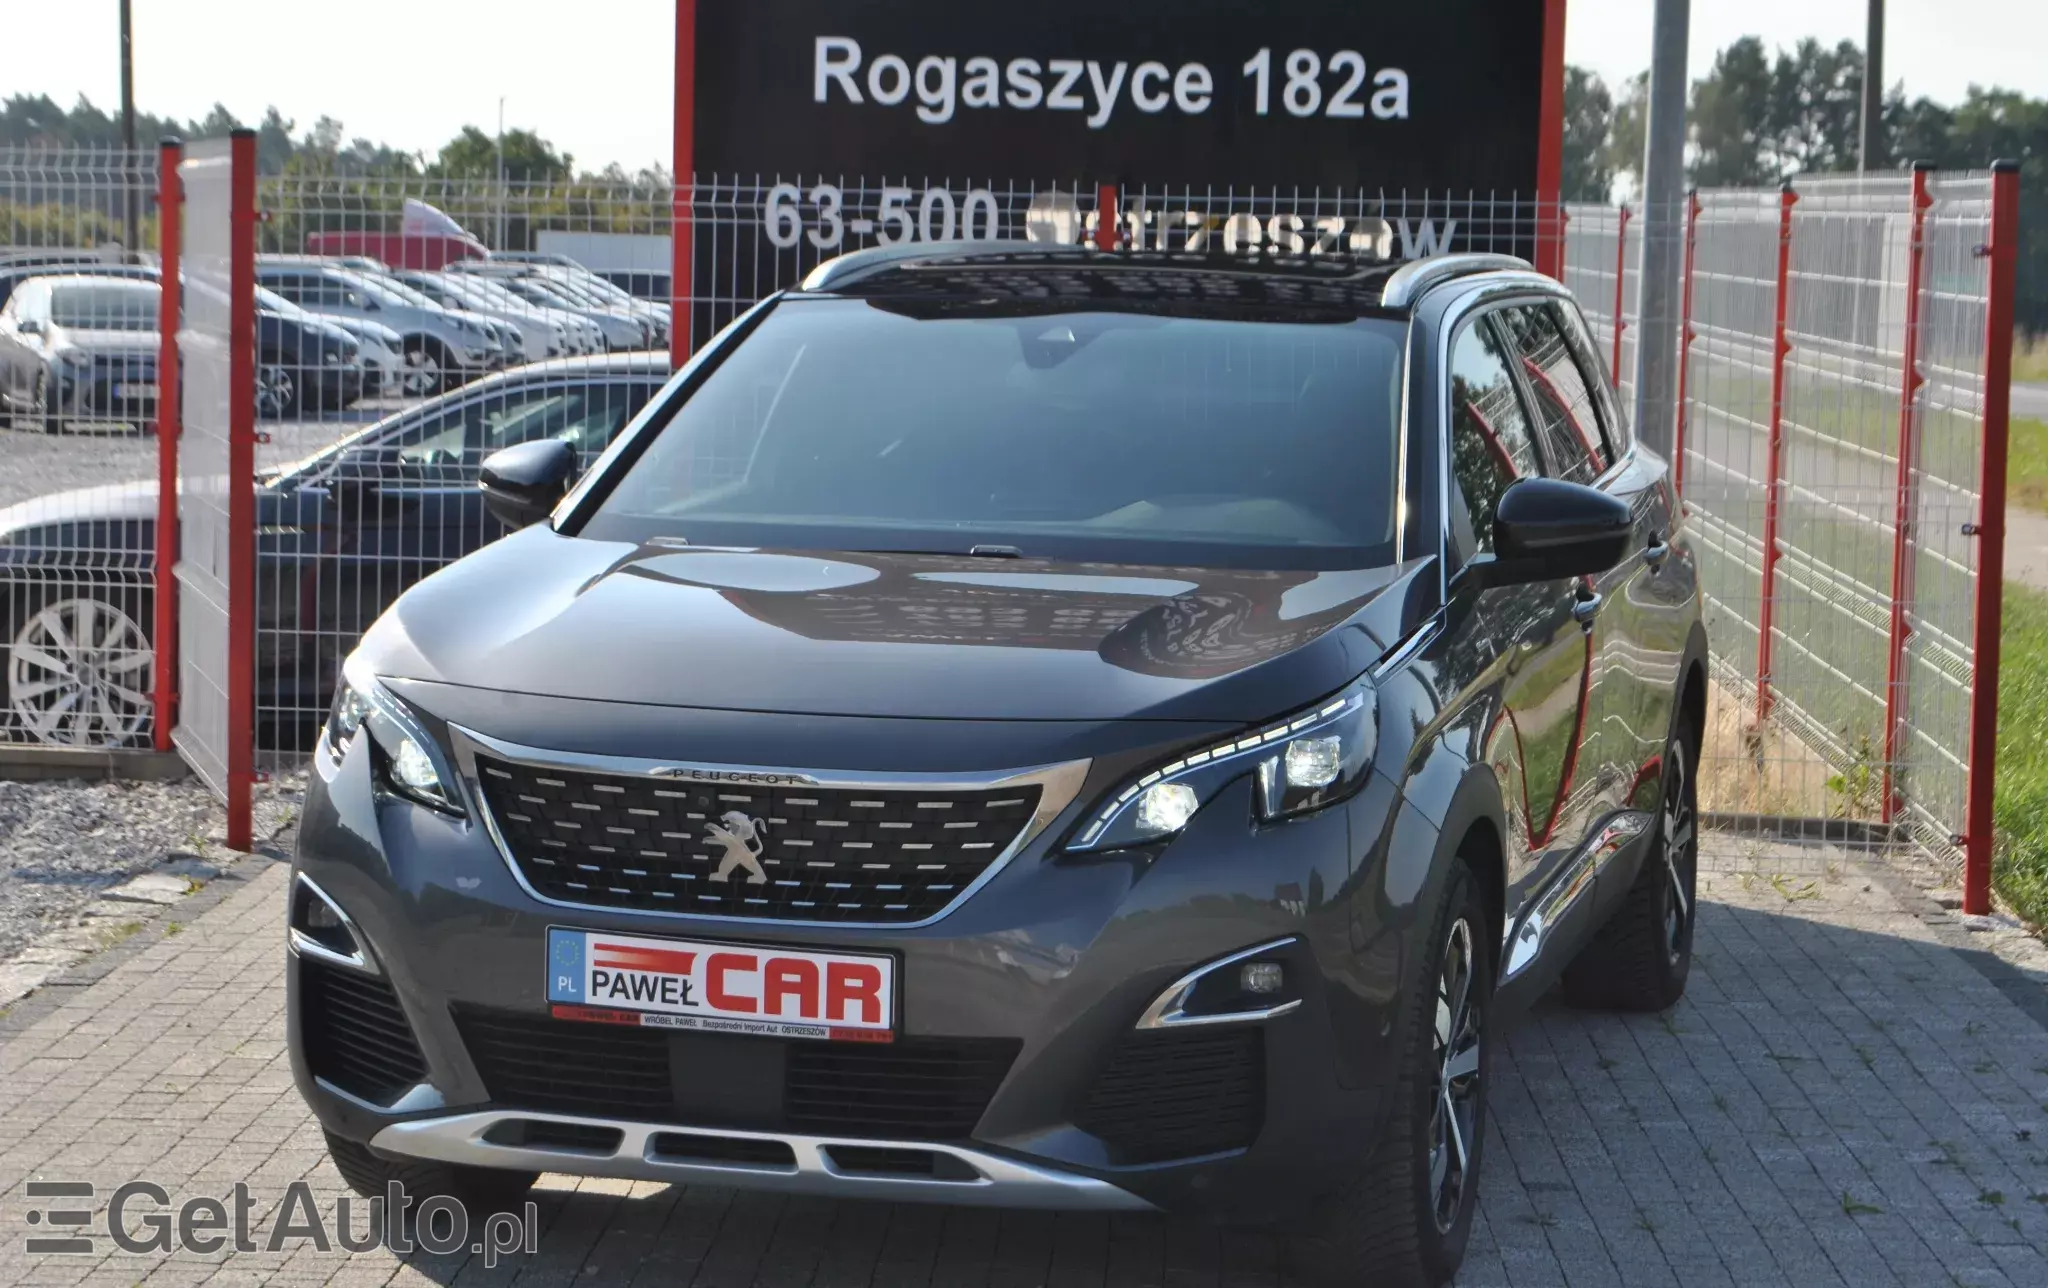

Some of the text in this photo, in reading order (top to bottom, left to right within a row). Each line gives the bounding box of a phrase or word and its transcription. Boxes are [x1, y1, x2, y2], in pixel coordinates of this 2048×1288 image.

[814, 36, 1410, 129] Rogaszyce 182a
[765, 183, 999, 249] 63-500
[673, 769, 797, 784] PEUGEOT
[558, 976, 577, 993] PL
[591, 970, 699, 1007] PAWEŁ
[706, 952, 882, 1024] CAR
[644, 1014, 674, 1025] WRÓBEL
[675, 1017, 698, 1027] PAWEŁ
[781, 1025, 827, 1036] OSTRZESZÓW
